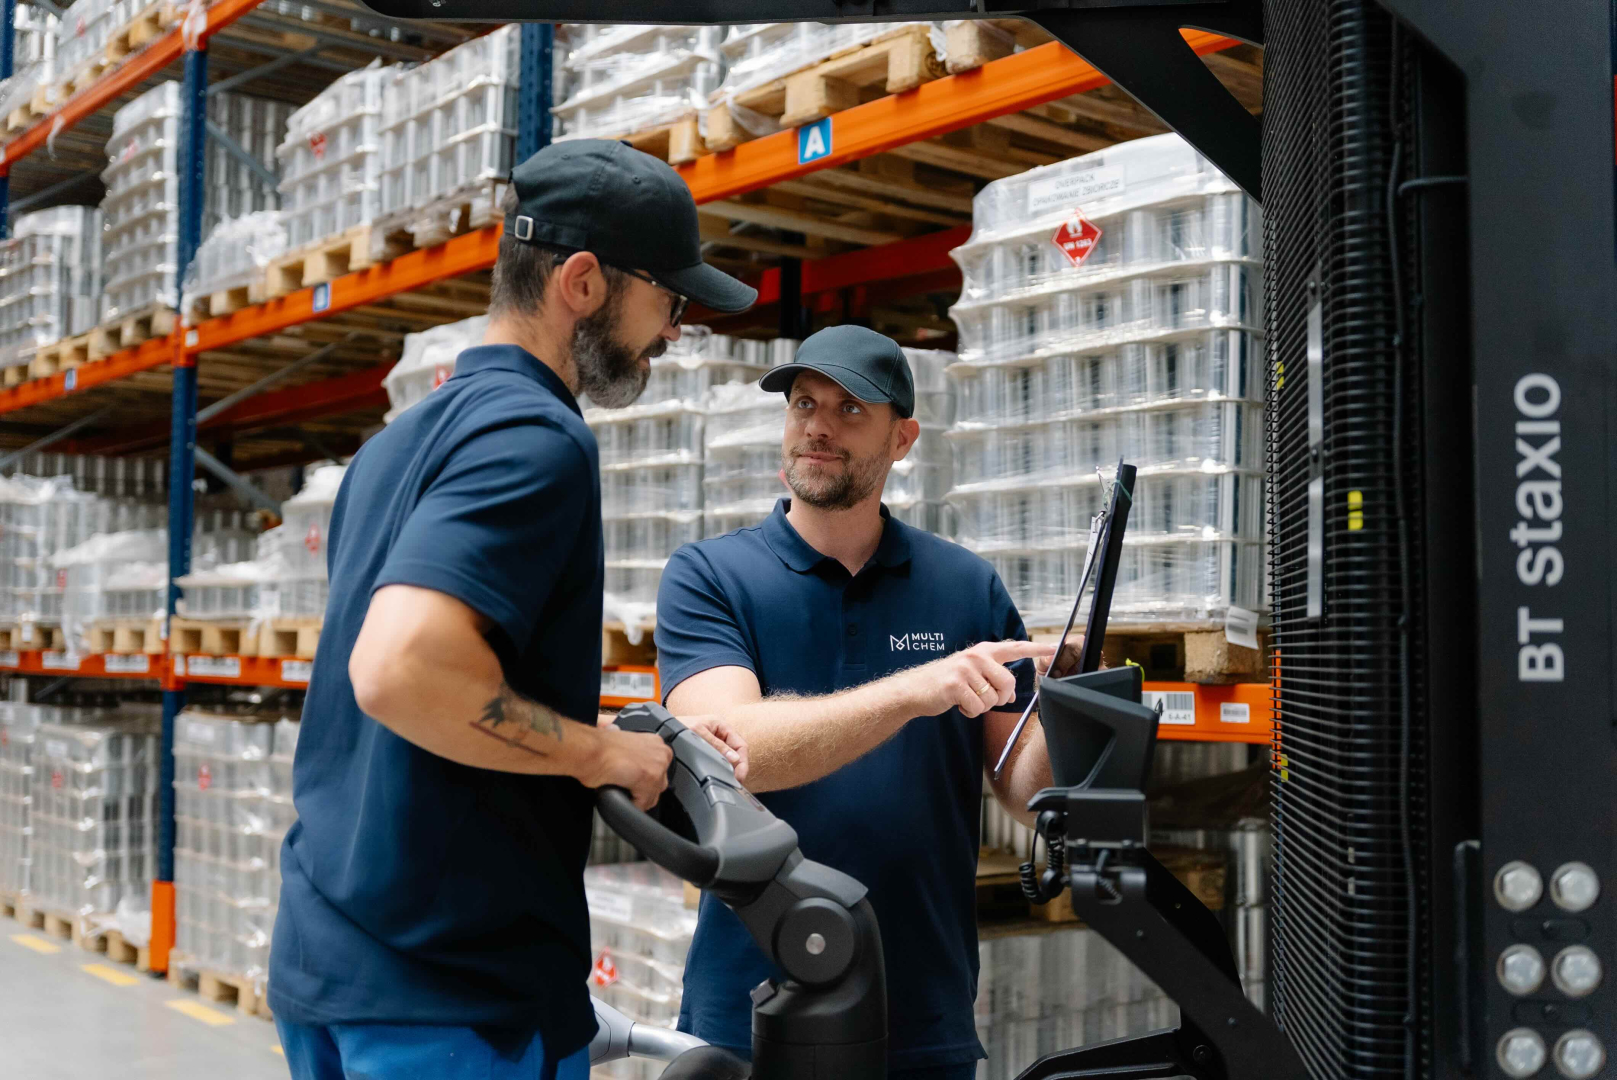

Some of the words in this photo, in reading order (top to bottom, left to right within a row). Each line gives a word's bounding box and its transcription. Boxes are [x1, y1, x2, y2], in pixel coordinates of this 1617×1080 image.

[803, 125, 826, 159] A
[1055, 173, 1095, 189] OVERPACK
[1082, 179, 1119, 196] ZBIORCZE
[911, 632, 944, 641] MULTI
[1517, 606, 1564, 682] BT
[912, 642, 945, 651] CHEM
